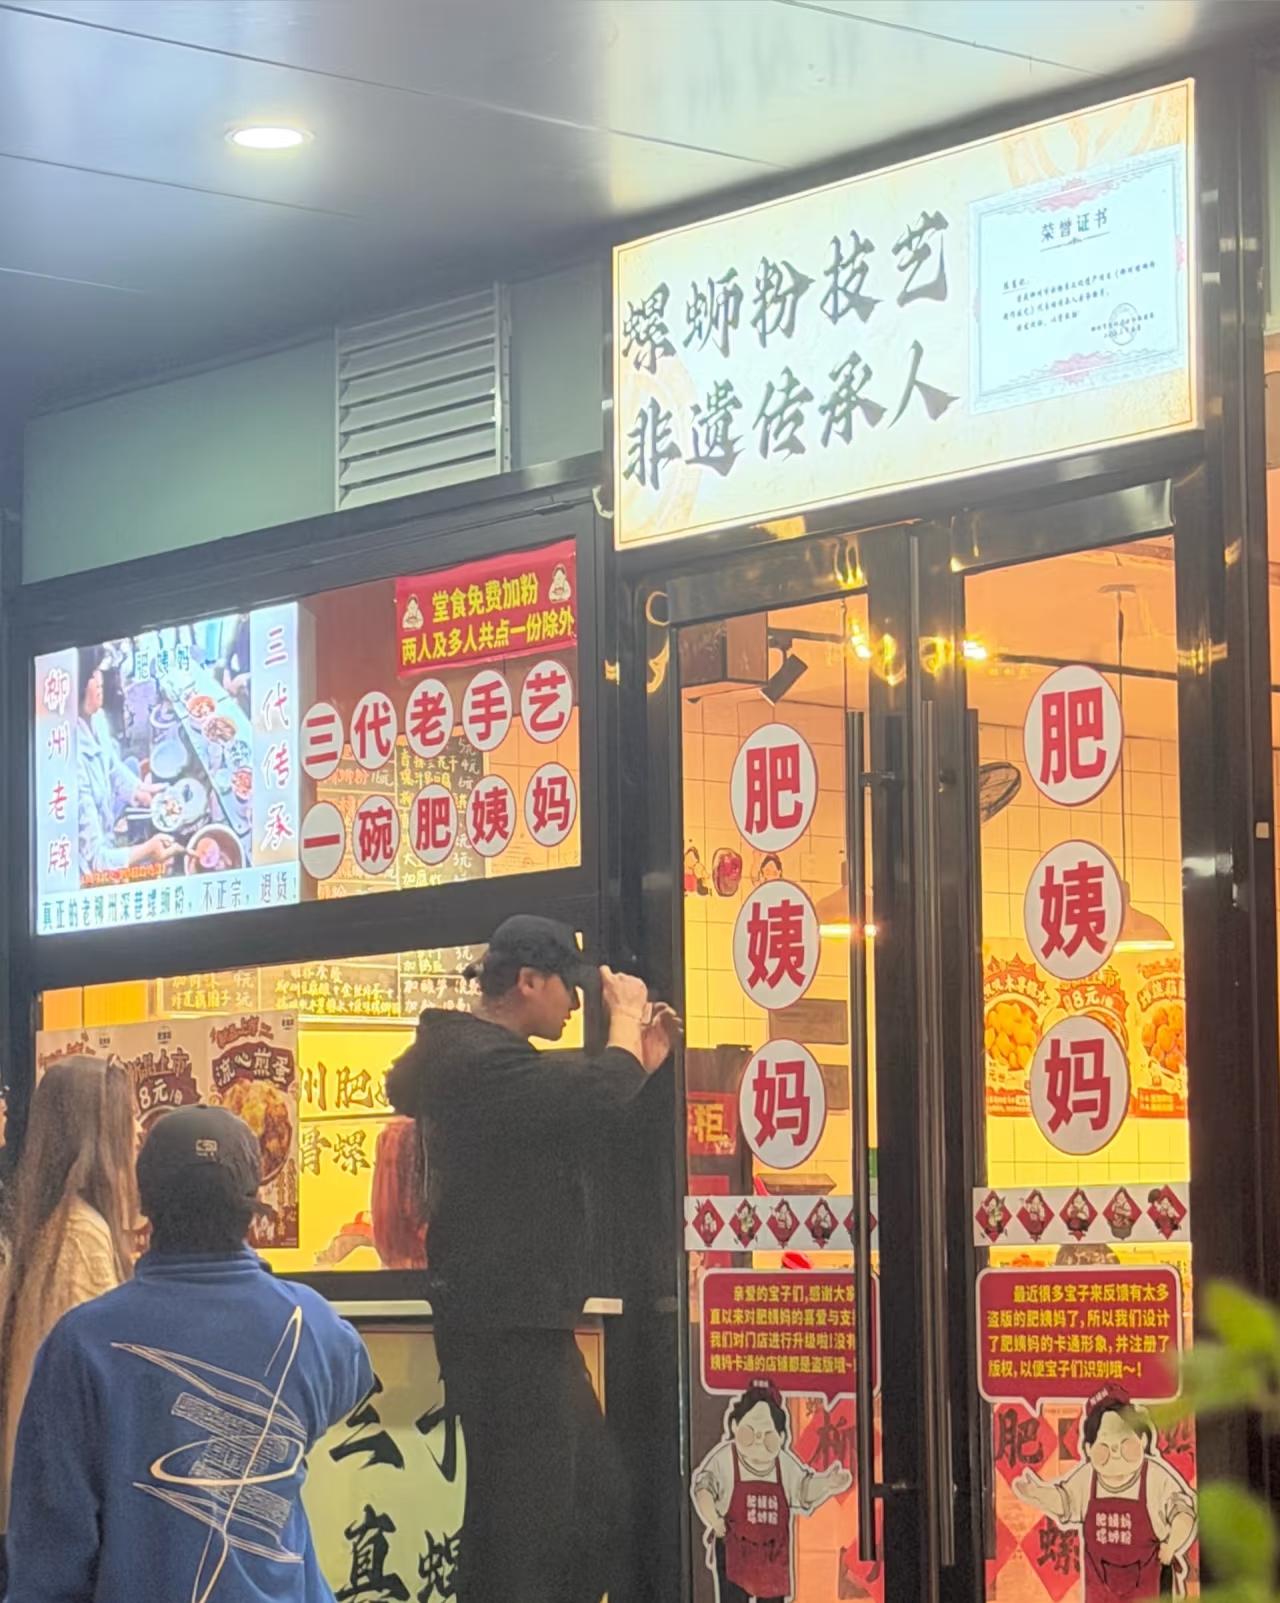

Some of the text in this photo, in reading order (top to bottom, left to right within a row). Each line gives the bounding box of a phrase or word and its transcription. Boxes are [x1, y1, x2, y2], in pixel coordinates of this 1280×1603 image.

[1041, 208, 1107, 242] 荣誉证书
[622, 210, 949, 374] 螺蛳粉技艺
[622, 340, 961, 490] 非遗传承人
[432, 572, 539, 623] 堂食免费加粉
[401, 605, 575, 666] 两人及多人共点一份除外
[260, 626, 294, 852] 三代传承
[304, 671, 570, 768] 三代老手艺
[43, 666, 72, 880] 柳州老牌
[304, 776, 571, 863] 一碗肥姨妈
[1039, 686, 1111, 1132] 肥姨妈
[745, 744, 811, 1147] 肥姨妈
[215, 1047, 291, 1087] 流心煎蛋
[300, 1061, 388, 1111] 州肥
[300, 1124, 377, 1176] 骨螺
[710, 1308, 855, 1326] 直以来对肥姨妈的喜爱与支
[1014, 1283, 1169, 1303] 最近很多宝子来反馈有太多
[995, 1407, 1044, 1468] 肥
